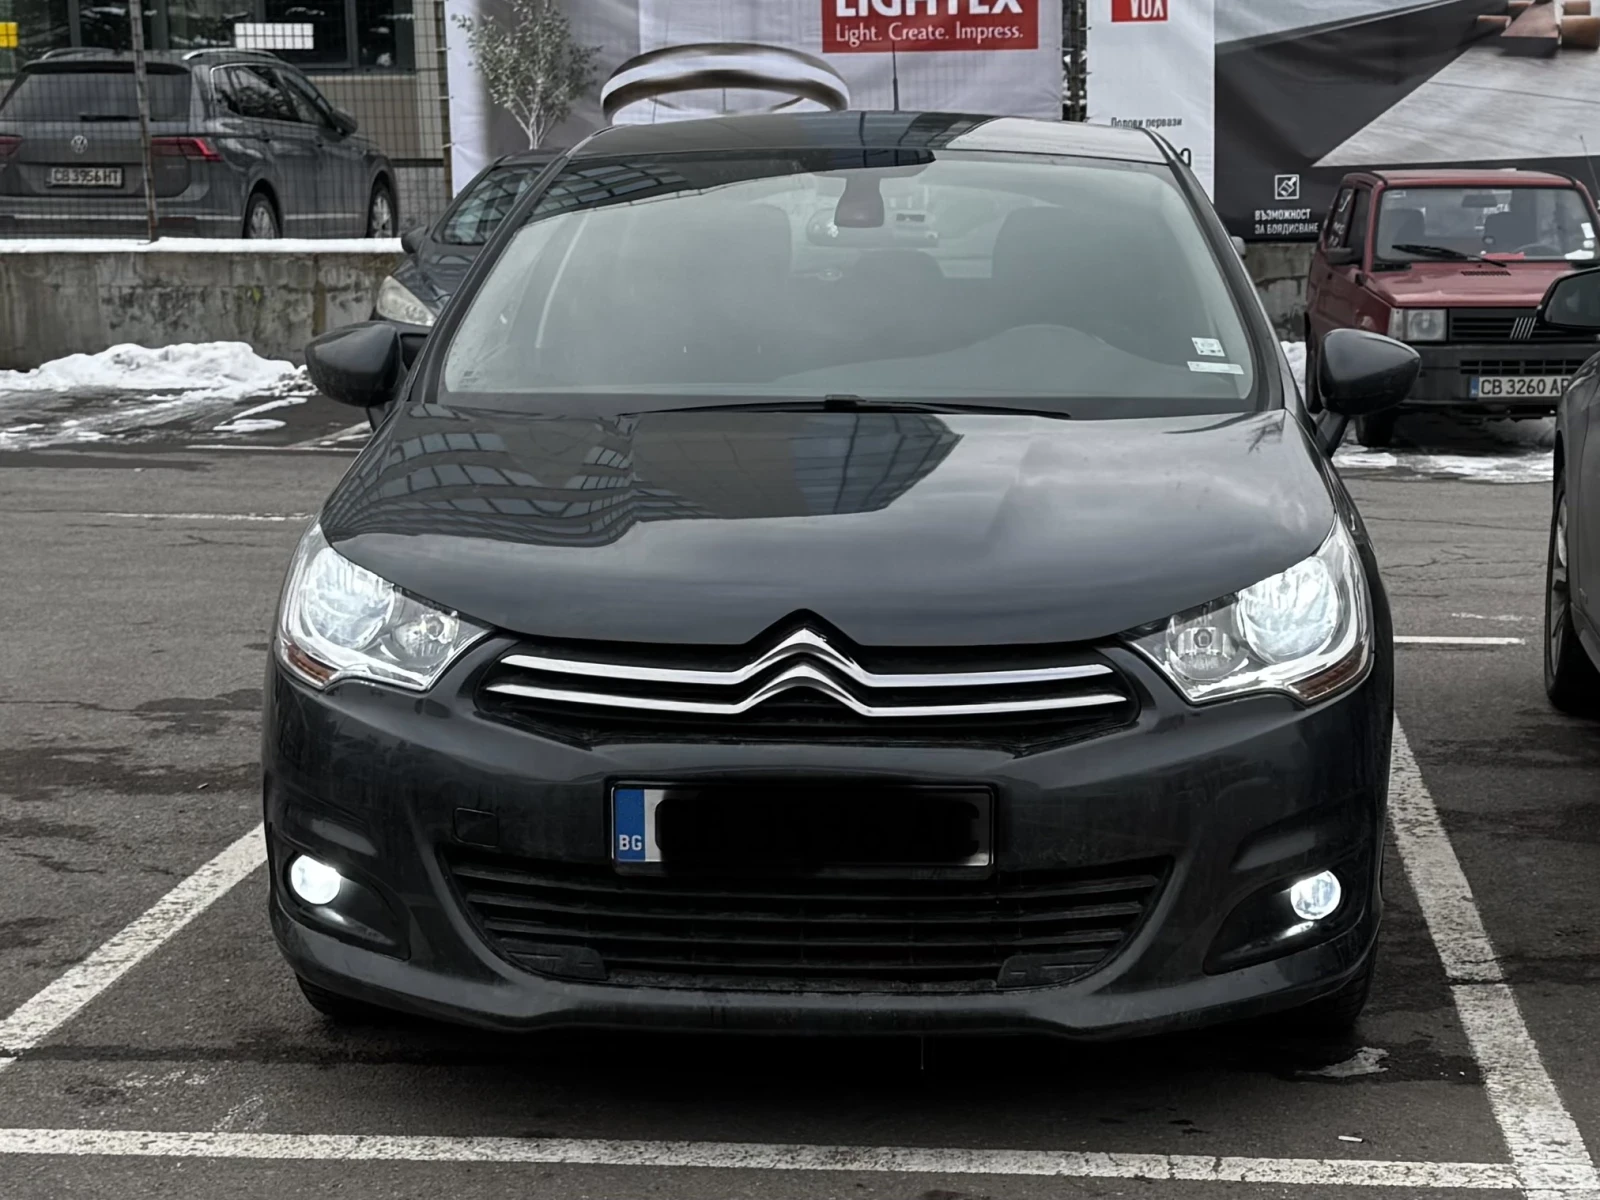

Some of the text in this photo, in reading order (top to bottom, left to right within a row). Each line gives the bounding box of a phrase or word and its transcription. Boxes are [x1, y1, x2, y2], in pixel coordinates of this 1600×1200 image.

[836, 21, 1024, 47] Light. Create. Impress.
[1146, 118, 1182, 128] первази
[1255, 208, 1311, 220] ВЪЗМОЖНОСТ
[1267, 222, 1319, 235] БОЯДИСВАНЕ
[1481, 379, 1503, 395] CB
[1505, 379, 1547, 395] 3260
[619, 834, 642, 851] BG
